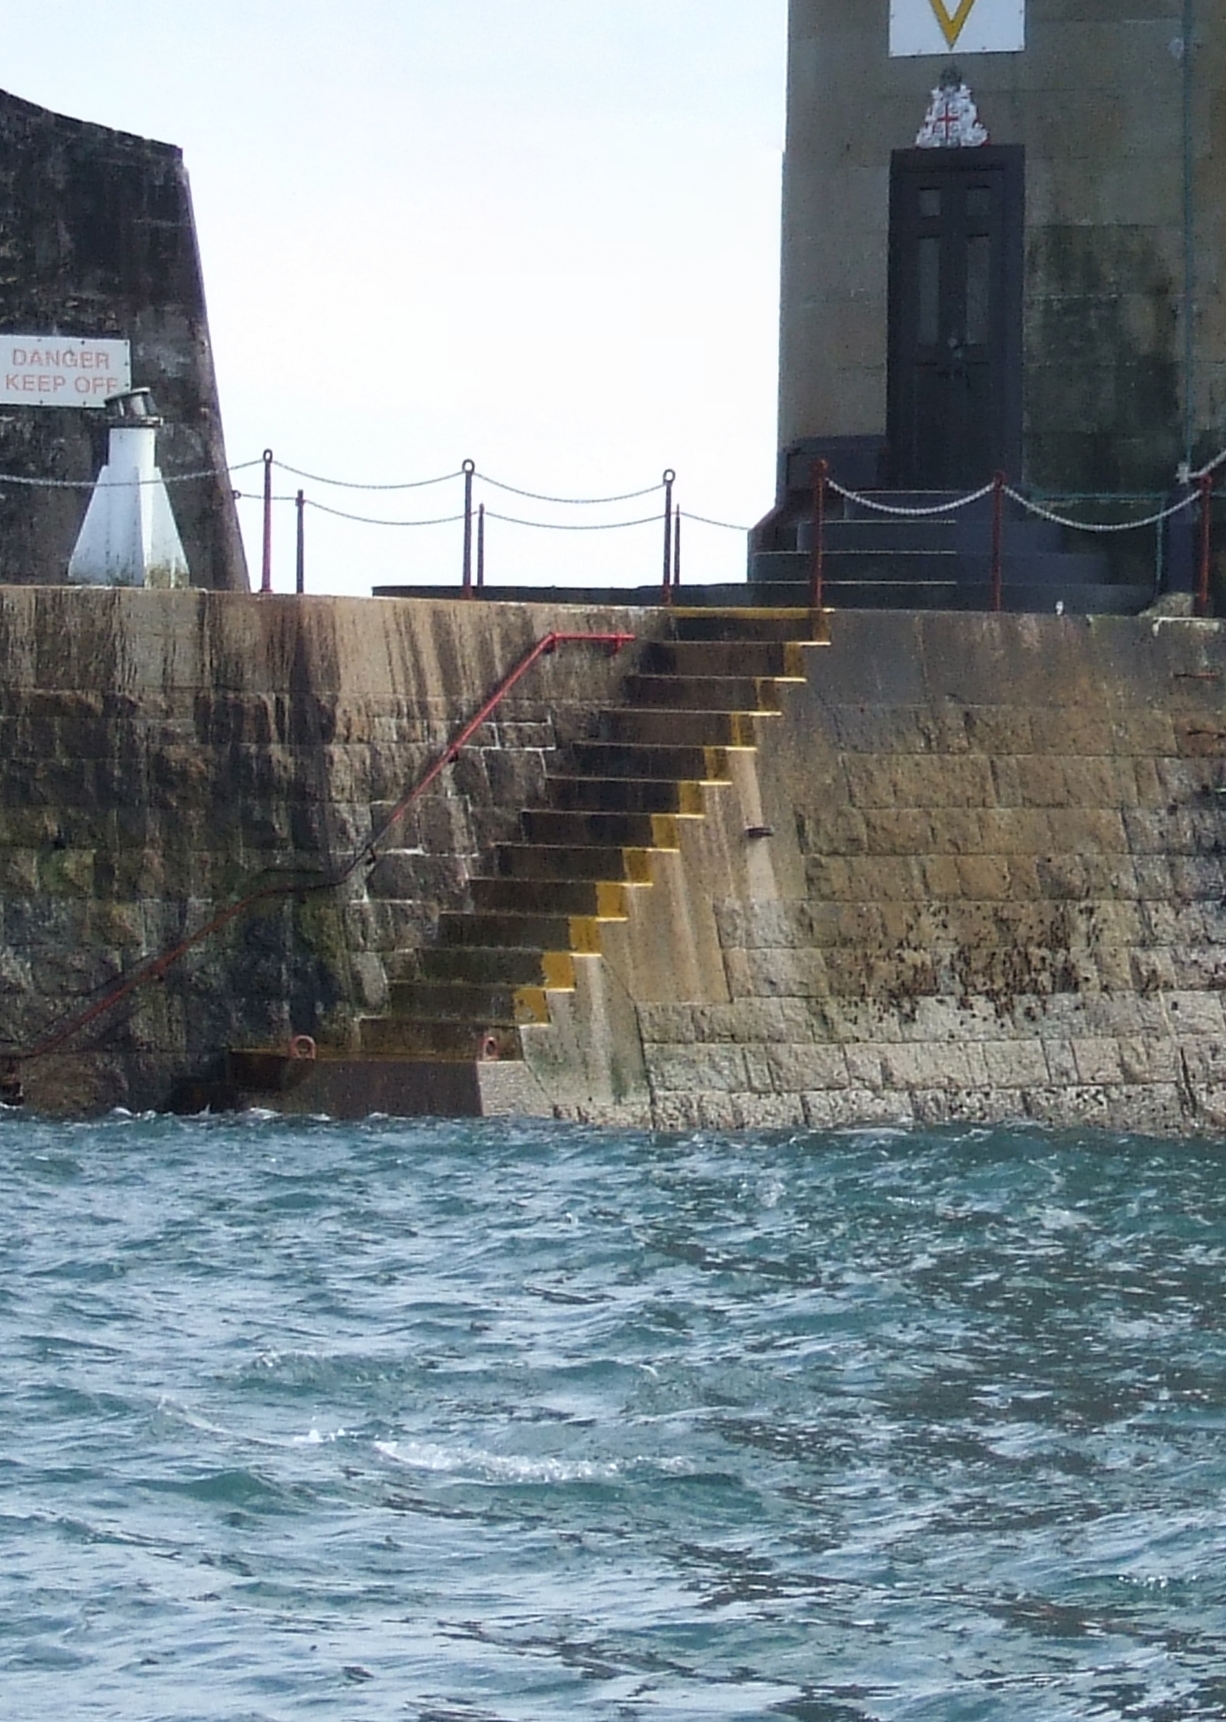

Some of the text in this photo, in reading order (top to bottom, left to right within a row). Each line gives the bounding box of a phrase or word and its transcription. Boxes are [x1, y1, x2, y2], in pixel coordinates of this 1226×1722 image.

[12, 349, 110, 370] DANGER
[6, 374, 119, 395] KEEP OFF
